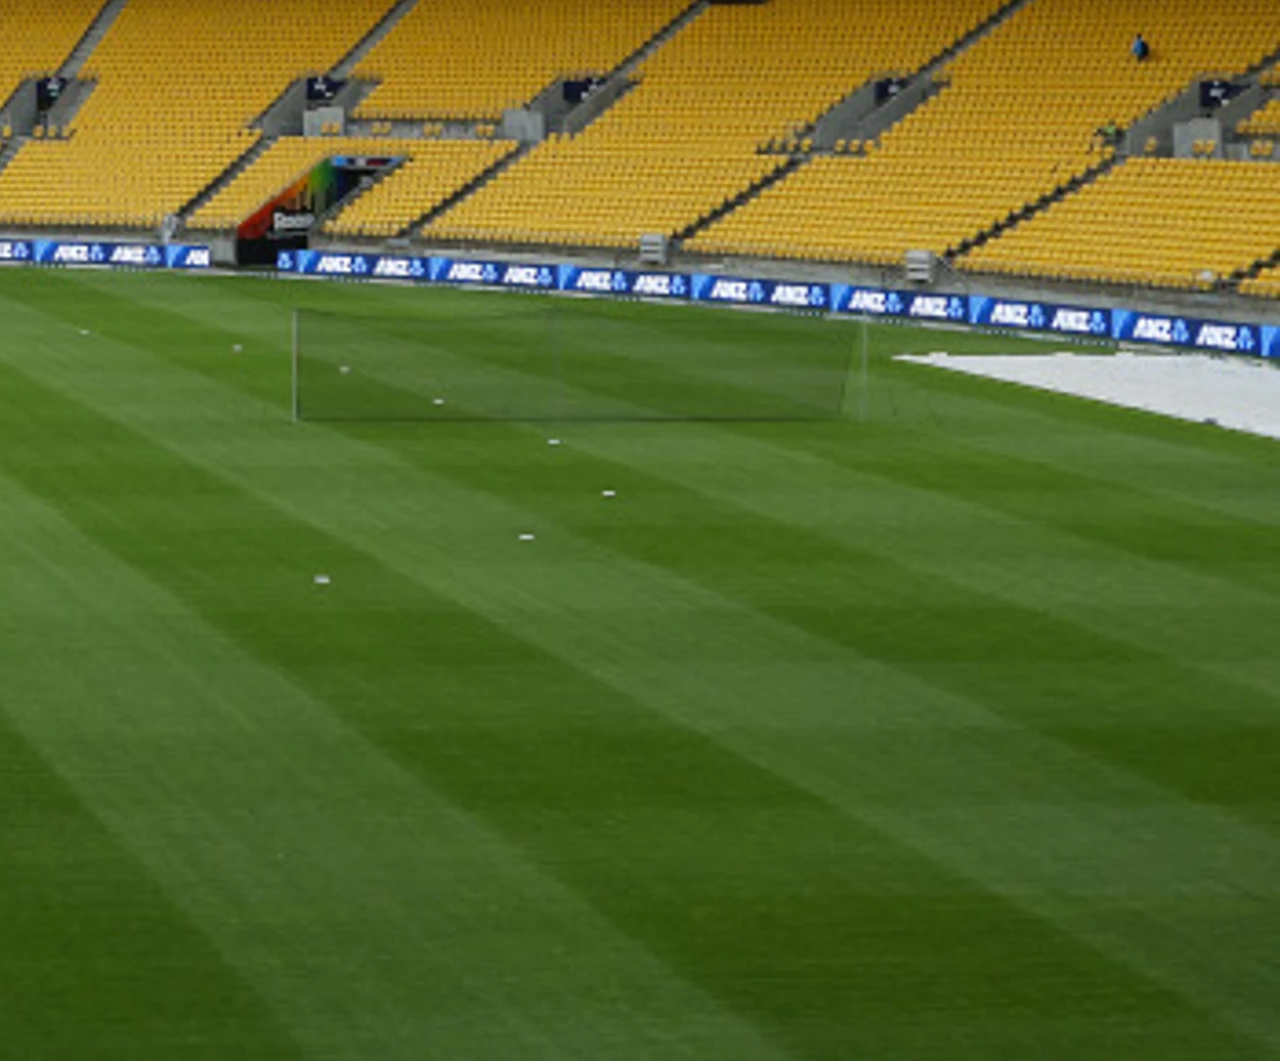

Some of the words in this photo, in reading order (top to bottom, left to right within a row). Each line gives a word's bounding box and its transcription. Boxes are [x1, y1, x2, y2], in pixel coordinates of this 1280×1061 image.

[54, 245, 89, 261] ANZ
[111, 246, 145, 263] ANZ
[317, 256, 352, 273] ANZ
[375, 259, 409, 276] ANZ
[449, 263, 483, 280] ANZ
[504, 267, 538, 284] ANZ
[577, 271, 611, 290] ANZ
[633, 275, 670, 294] ANZ
[712, 281, 747, 300] ANZ
[771, 285, 809, 305] ANZ
[849, 291, 885, 312] ANZ
[910, 297, 948, 317] ANZ
[991, 304, 1028, 325] ANZ
[1052, 310, 1090, 331] ANZ
[1133, 318, 1172, 341] ANZ
[1197, 325, 1236, 349] ANZ
